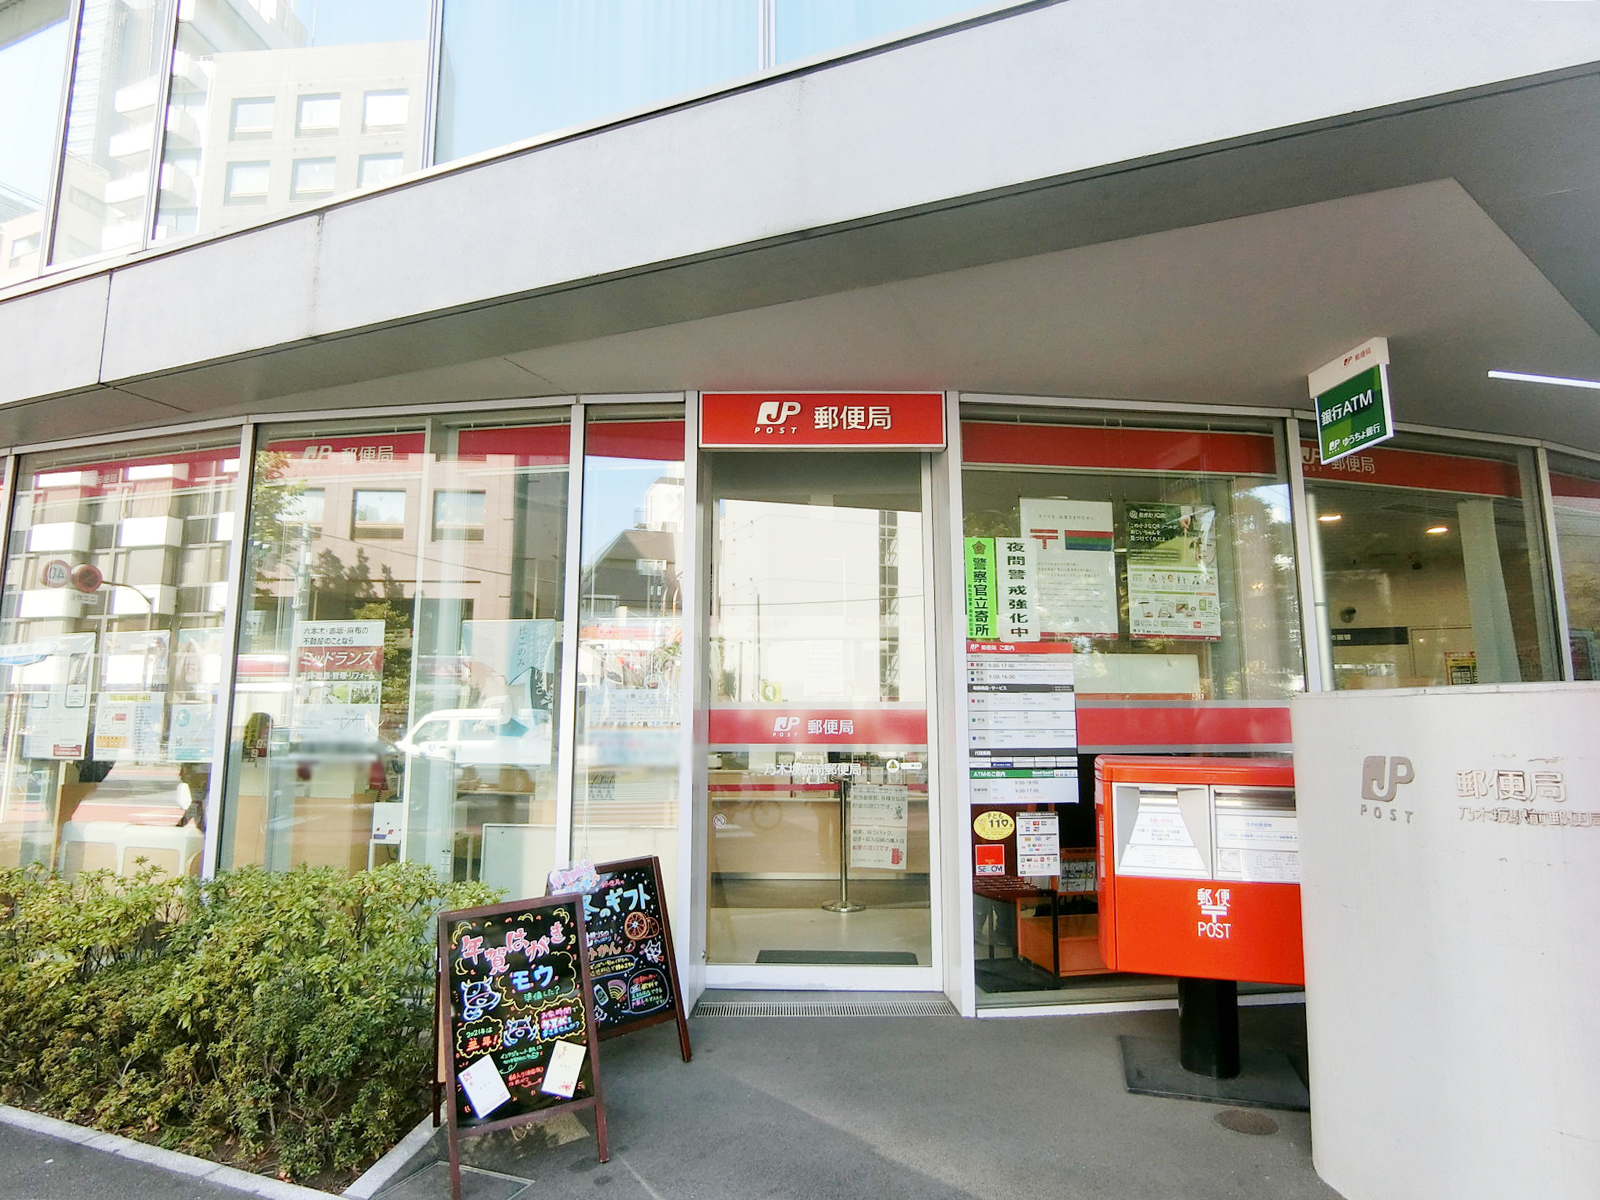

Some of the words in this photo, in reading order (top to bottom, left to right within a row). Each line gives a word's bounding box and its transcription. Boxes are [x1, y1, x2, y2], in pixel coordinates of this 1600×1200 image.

[757, 401, 802, 425] JP
[814, 405, 893, 430] 郵便局
[1320, 389, 1374, 426] 銀行ATM
[754, 426, 799, 435] POST
[1342, 422, 1381, 447] ゆうちょ銀行
[340, 445, 394, 465] 郵便局
[1331, 456, 1376, 474] 郵便局
[972, 557, 989, 636] 警察官立寄所
[1006, 542, 1029, 637] 夜間警戒強化中
[303, 626, 369, 635] 六本木・赤坂・麻布の
[303, 637, 354, 645] 不動産のことなら
[300, 650, 377, 667] ミッドランズ
[774, 717, 801, 732] JP
[807, 719, 854, 735] 郵便局
[764, 763, 862, 776] 乃木坂駅前郵便局
[1361, 756, 1415, 803] JP
[1456, 769, 1567, 803] 郵便局
[1360, 804, 1415, 825] POST
[583, 883, 651, 922] 冬のギフト
[1196, 888, 1231, 907] 郵便
[1197, 922, 1232, 939] POST
[462, 921, 566, 975] 年賀はがき
[512, 965, 553, 991] モウ
